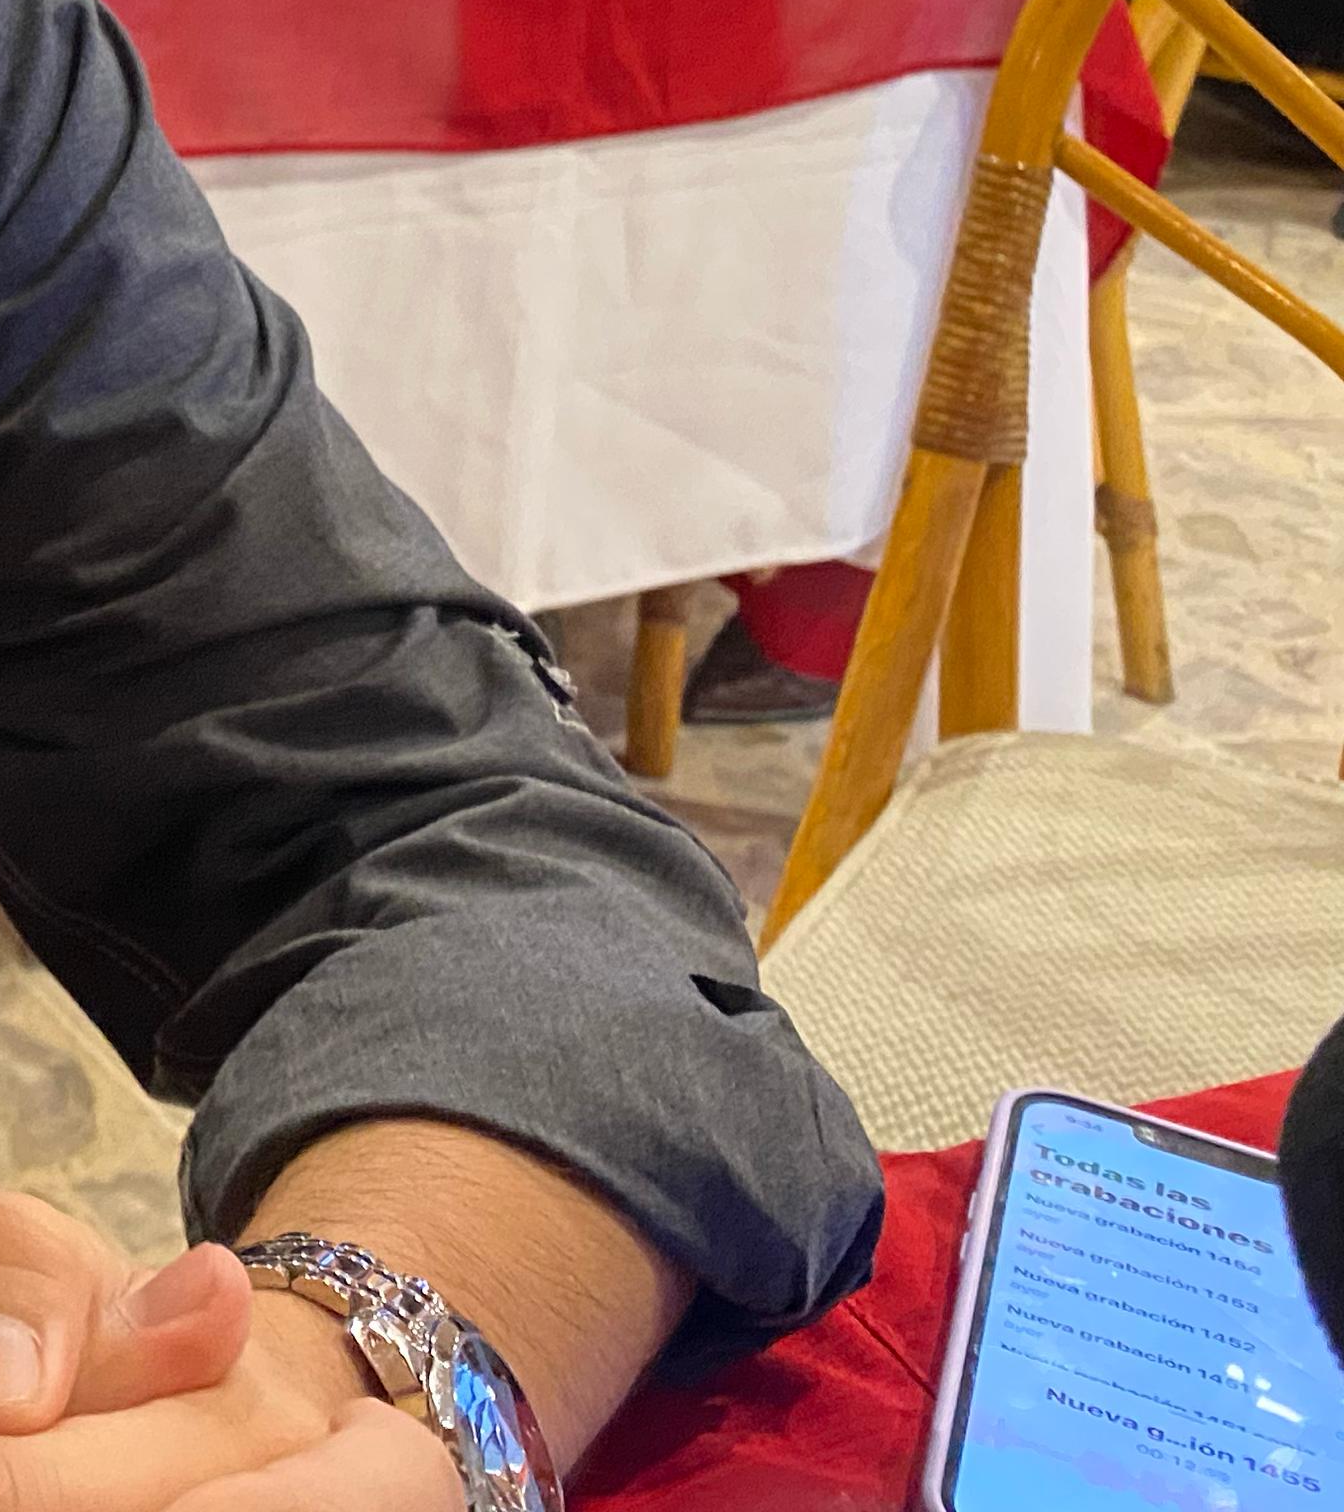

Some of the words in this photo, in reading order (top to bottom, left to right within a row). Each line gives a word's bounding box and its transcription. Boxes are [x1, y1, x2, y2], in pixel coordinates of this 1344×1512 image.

[1034, 1141, 1146, 1191] Todas
[1155, 1181, 1212, 1211] las
[1025, 1192, 1091, 1221] Nueva
[1094, 1215, 1201, 1256] grabación
[1030, 1169, 1275, 1255] grabaciones
[1019, 1227, 1086, 1258] Nueva
[1089, 1253, 1199, 1295] grabación
[1006, 1303, 1074, 1334] Nueva
[1079, 1329, 1192, 1375] grabación
[1013, 1265, 1080, 1295] Nueva
[1085, 1291, 1195, 1335] grabación
[1200, 1327, 1256, 1354] 1452
[1046, 1387, 1139, 1431] Nueva
